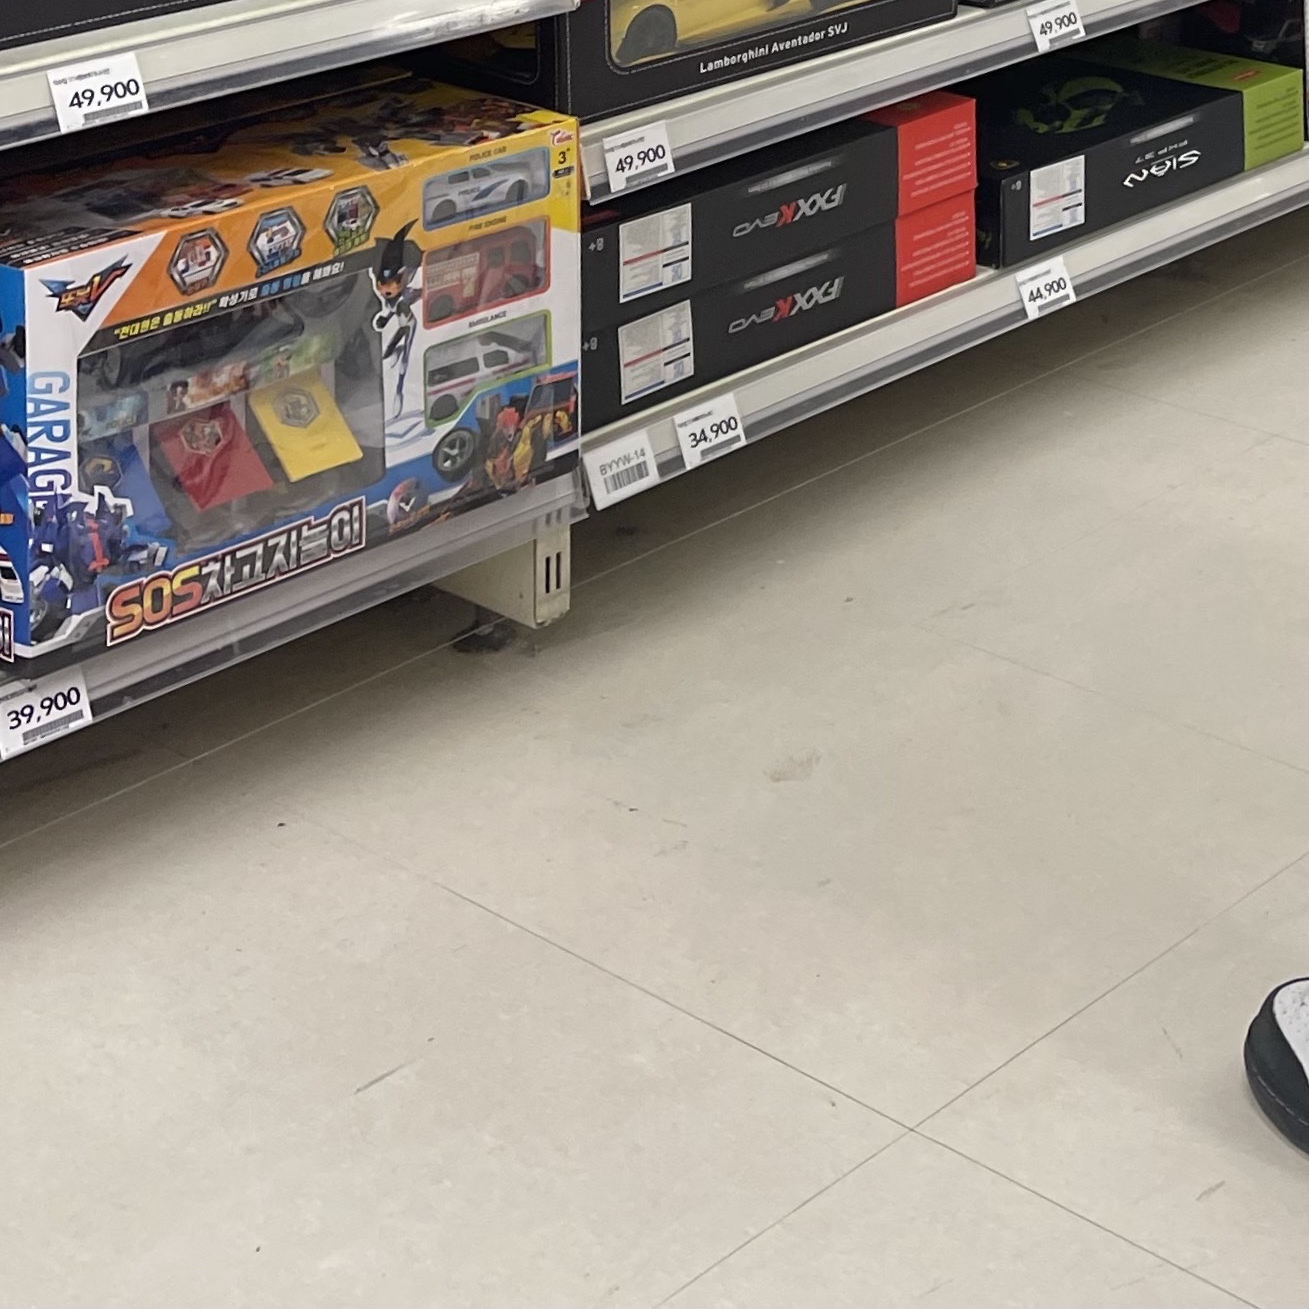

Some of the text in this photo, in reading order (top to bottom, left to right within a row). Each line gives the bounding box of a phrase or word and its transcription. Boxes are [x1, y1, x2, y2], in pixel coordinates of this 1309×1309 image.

[1038, 11, 1078, 36] 49,900
[699, 20, 850, 75] Lamborghini Aventador SVJ
[68, 76, 141, 110] 49,900
[614, 144, 666, 174] 49,900
[1028, 278, 1067, 304] 44,900
[689, 416, 738, 449] 34,900
[110, 500, 363, 639] SOS차고지능이
[7, 687, 81, 730] 39,900
